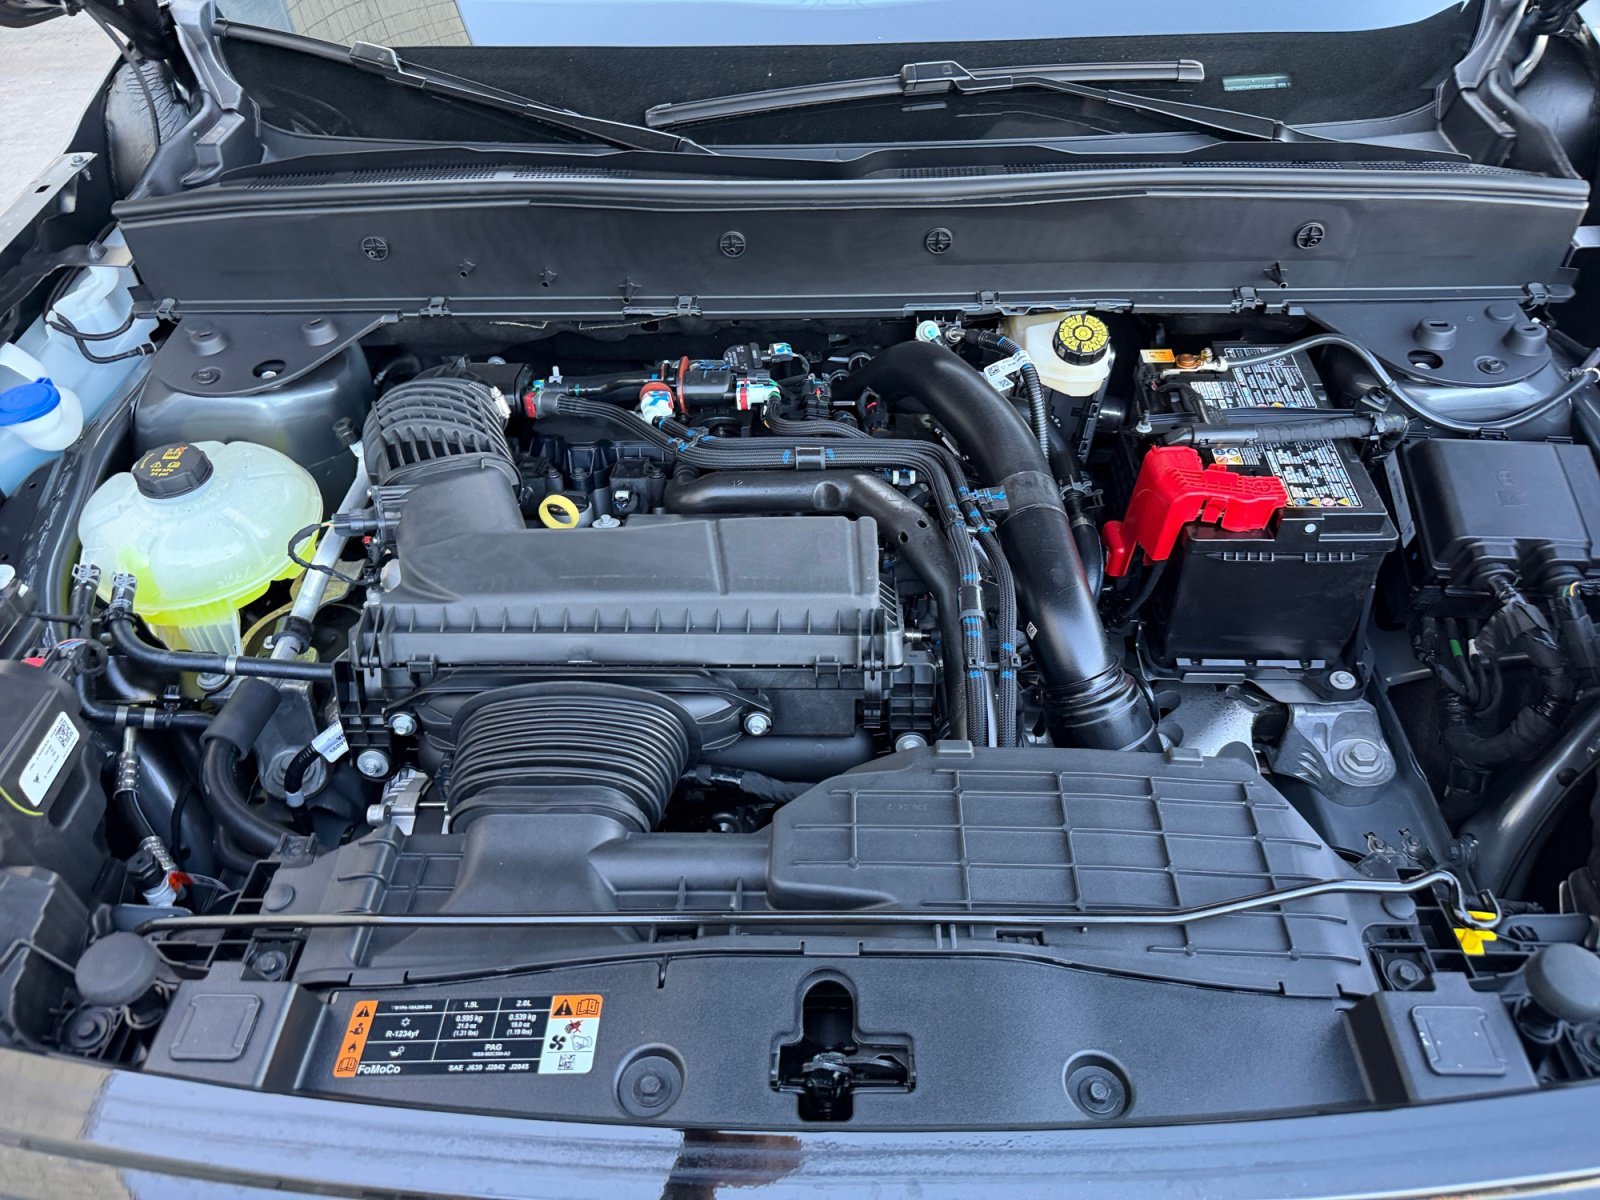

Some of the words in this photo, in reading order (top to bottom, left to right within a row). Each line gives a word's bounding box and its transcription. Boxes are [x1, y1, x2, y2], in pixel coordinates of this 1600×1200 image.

[474, 1015, 483, 1023] kg
[528, 1013, 536, 1021] kg
[385, 1030, 420, 1038] R-1234yf
[357, 1064, 401, 1074] FoMoCo
